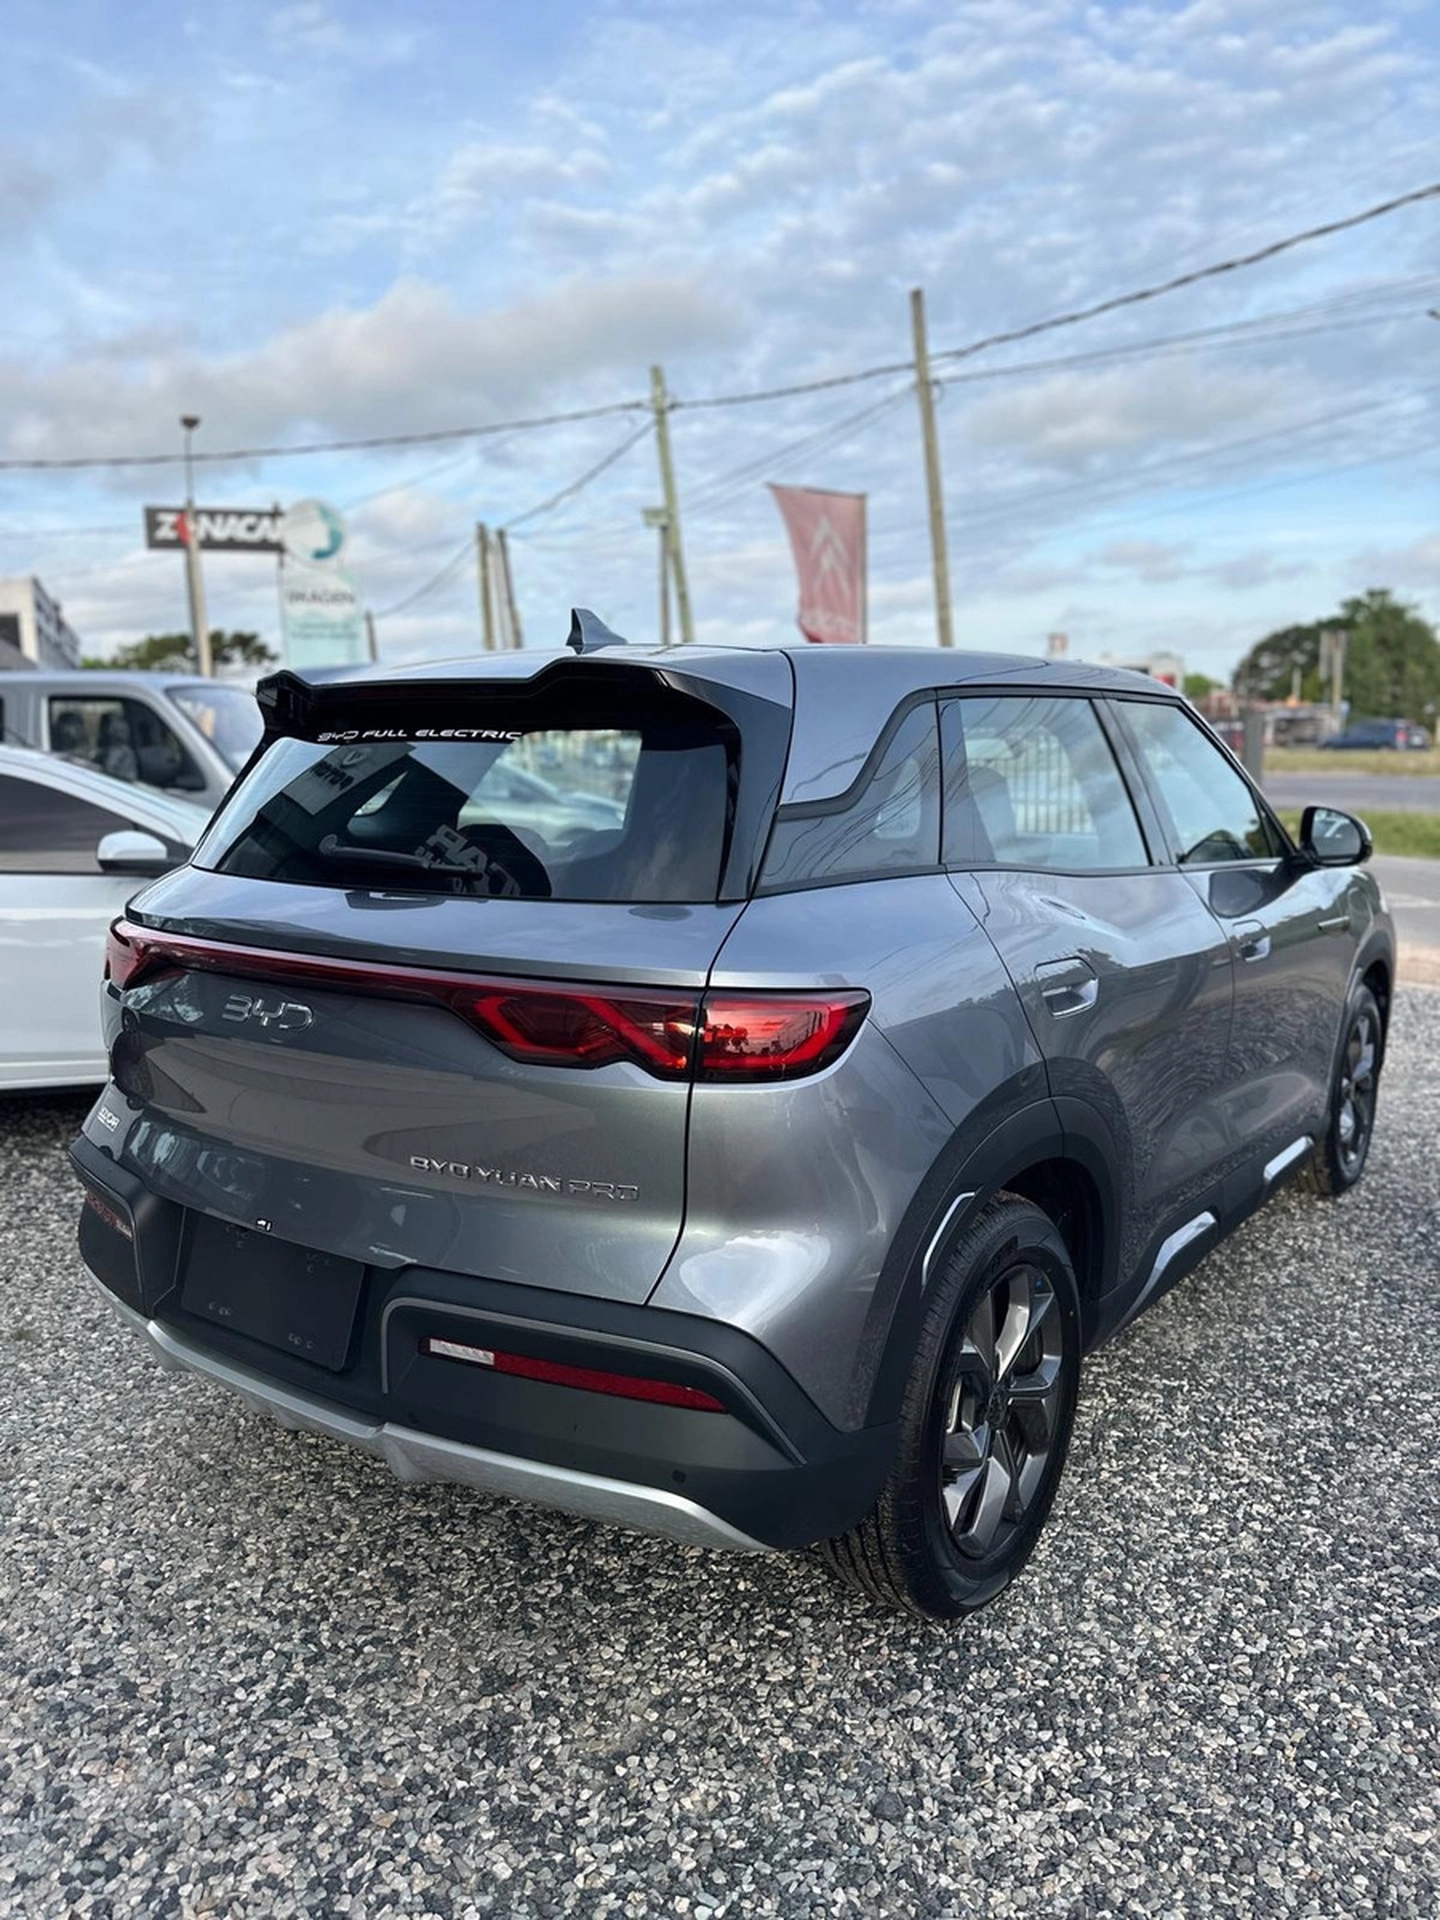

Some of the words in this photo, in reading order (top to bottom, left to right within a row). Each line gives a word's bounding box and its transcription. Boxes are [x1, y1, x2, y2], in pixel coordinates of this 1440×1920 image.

[362, 729, 408, 739] FULL
[415, 729, 523, 741] ELECTRIC
[222, 994, 314, 1031] BYD
[409, 1155, 471, 1179] BYD
[476, 1166, 562, 1194] YUAN
[568, 1179, 640, 1201] PRO
